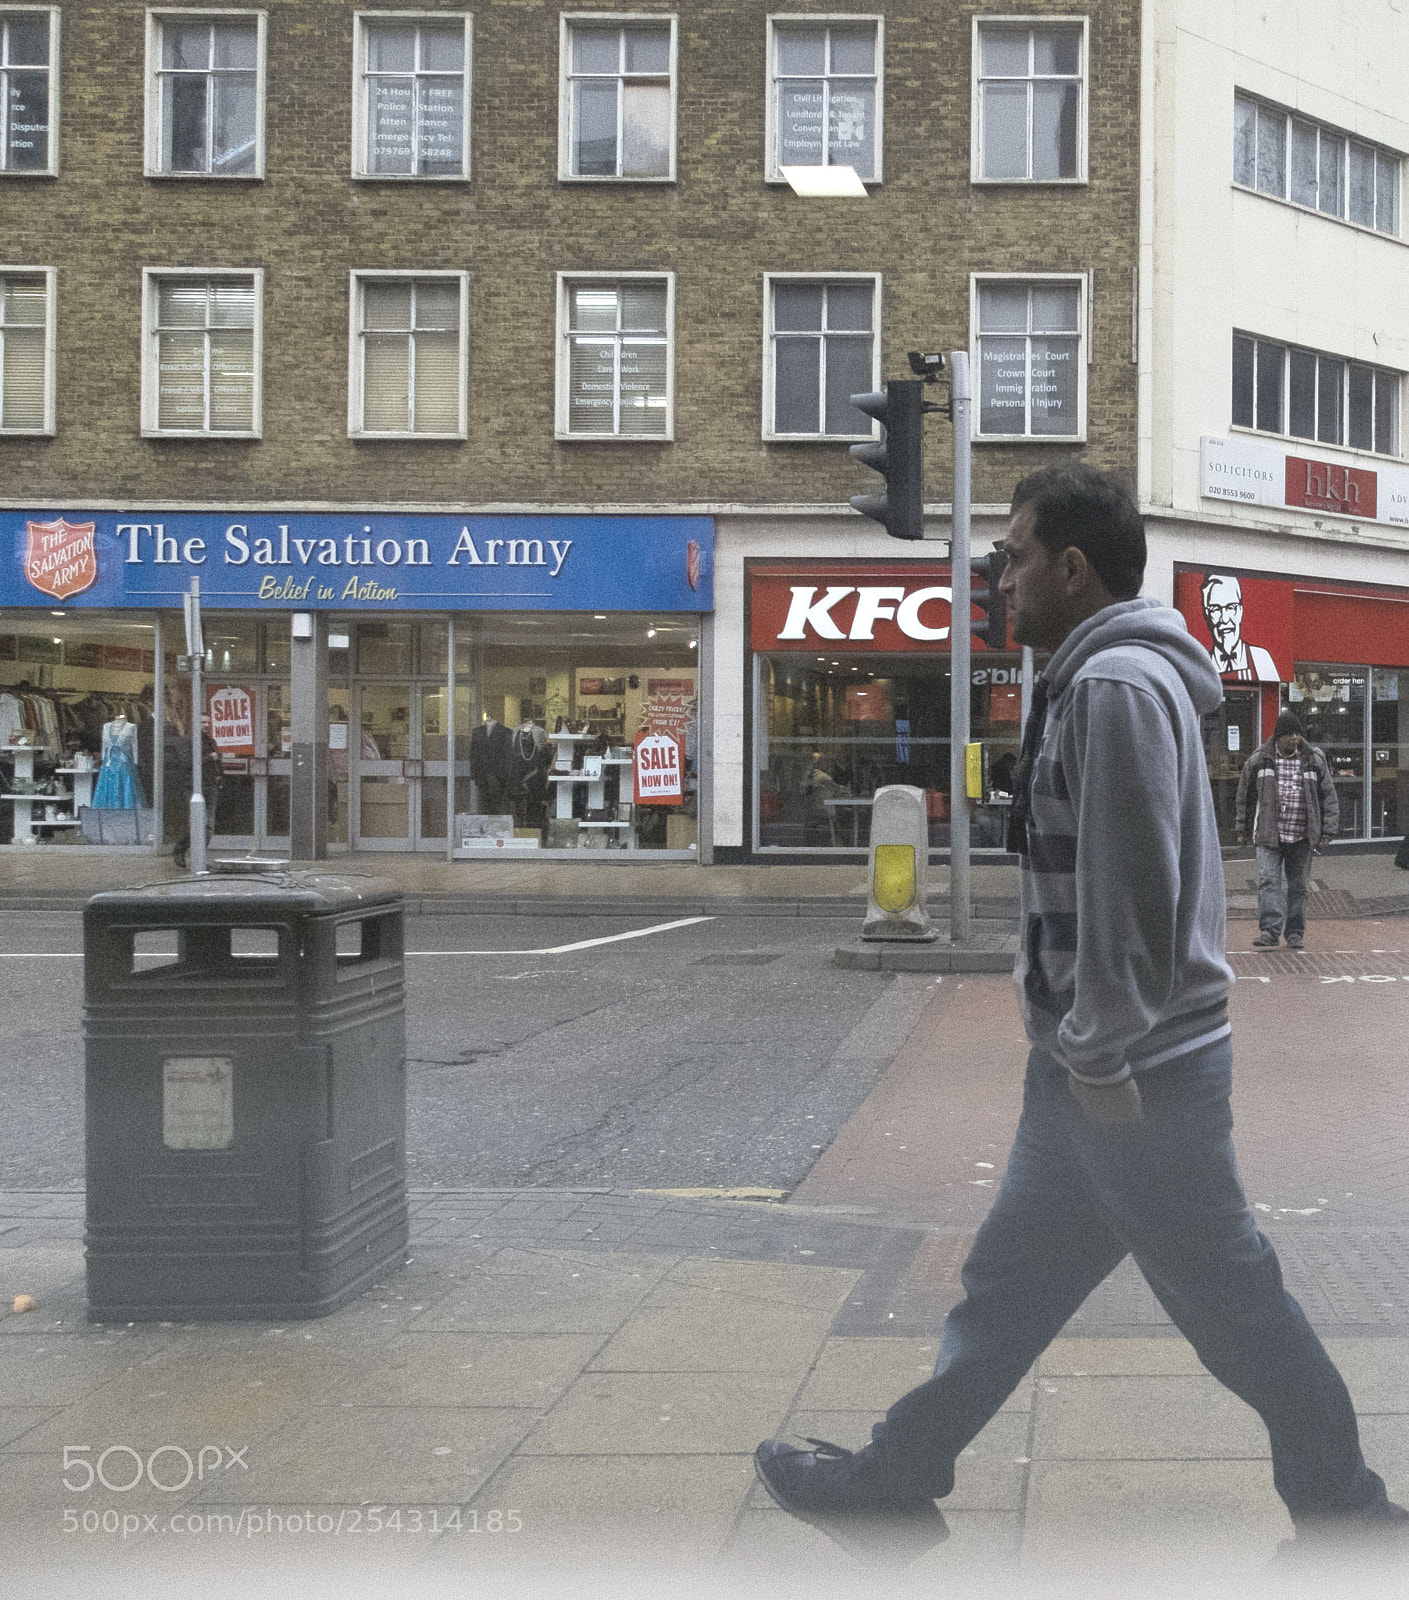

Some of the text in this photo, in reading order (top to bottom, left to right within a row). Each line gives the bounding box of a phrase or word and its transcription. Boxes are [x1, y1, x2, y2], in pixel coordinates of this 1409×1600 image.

[376, 88, 388, 96] 24
[429, 89, 454, 97] FREE
[793, 94, 811, 102] Civil
[377, 103, 454, 112] Police Station
[787, 110, 823, 119] Landlord
[844, 140, 861, 148] Law
[1045, 351, 1070, 361] Court
[997, 368, 1056, 378] Crown Court
[1036, 398, 1063, 409] Injury
[1209, 462, 1274, 482] SOLICITORS
[1209, 486, 1222, 495] 020
[1305, 462, 1360, 504] hkh
[42, 528, 68, 553] THE
[30, 531, 92, 579] SALVATION
[116, 523, 573, 577] The Salvation Army
[52, 554, 89, 590] ARMY
[258, 575, 399, 601] Belief in Action
[776, 586, 953, 641] KFC
[213, 698, 249, 722] SALE
[215, 724, 250, 738] NOW ON!
[640, 746, 677, 771] SALE
[641, 773, 679, 788] NOW ON!
